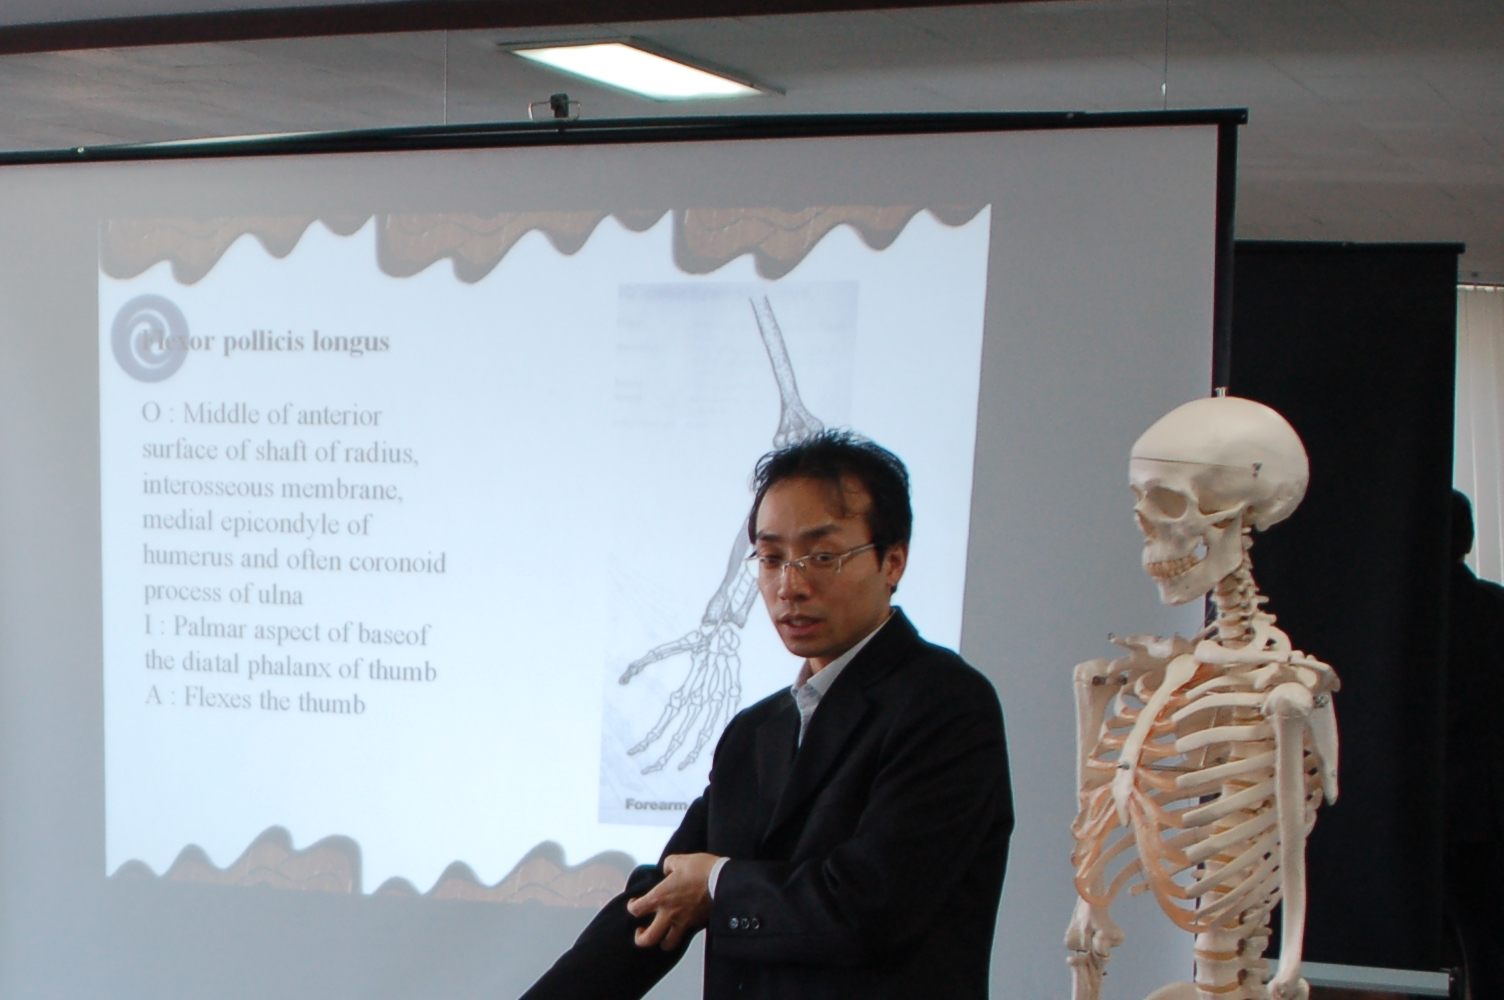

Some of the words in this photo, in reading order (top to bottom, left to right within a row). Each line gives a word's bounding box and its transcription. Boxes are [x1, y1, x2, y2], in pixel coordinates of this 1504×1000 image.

[223, 329, 305, 358] pollicis
[312, 329, 390, 358] longus
[142, 401, 161, 422] O
[184, 402, 260, 424] Middle
[267, 403, 294, 424] of
[297, 405, 383, 426] anterior
[143, 437, 218, 460] surface
[226, 438, 251, 461] of
[255, 439, 307, 462] shaft
[315, 441, 340, 462] of
[345, 444, 419, 467] radius,
[143, 472, 274, 498] interosseous
[281, 477, 403, 503] membrane,
[143, 508, 213, 531] medial
[221, 510, 339, 540] epicondyle
[347, 513, 373, 536] of
[143, 543, 233, 568] humerus
[241, 547, 279, 569] and
[286, 548, 341, 571] often
[349, 551, 446, 574] coronoid
[144, 582, 221, 605] process
[229, 582, 254, 603] of
[259, 584, 303, 606] ulna
[174, 615, 247, 639] Palmar
[254, 623, 320, 647] aspect
[327, 621, 352, 644] of
[145, 648, 174, 671] the
[248, 654, 331, 680] phalanx
[338, 657, 364, 679] of
[368, 659, 437, 682] thumb
[145, 684, 163, 705] A
[185, 685, 252, 709] Flexes
[259, 689, 291, 712] the
[298, 691, 366, 715] thumb
